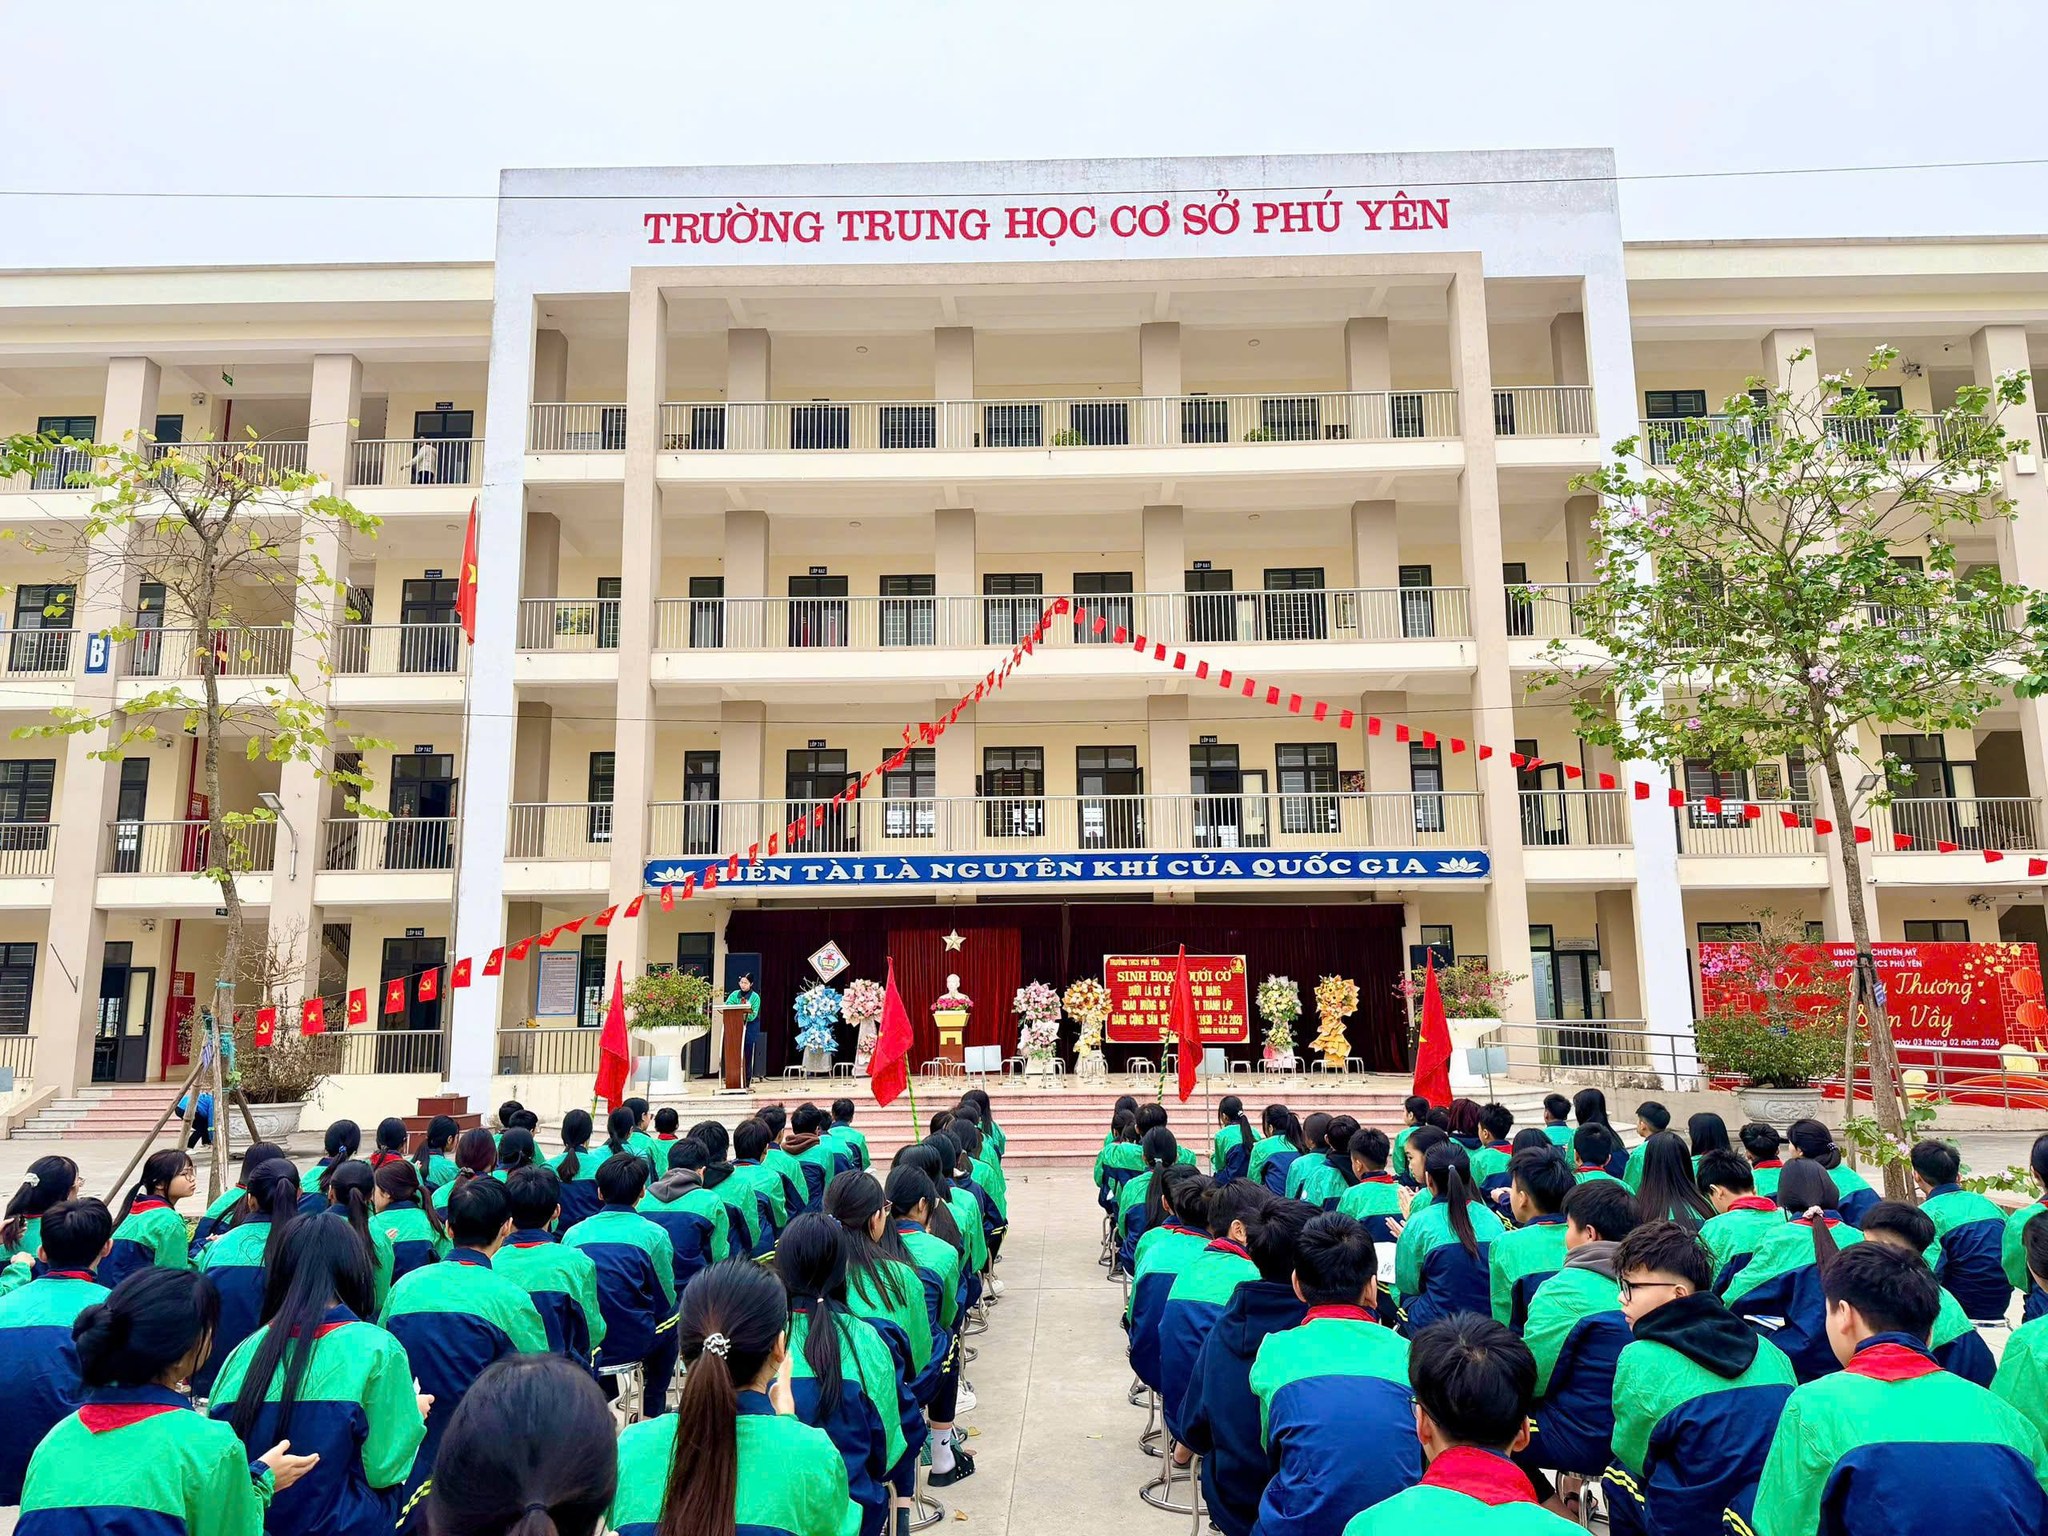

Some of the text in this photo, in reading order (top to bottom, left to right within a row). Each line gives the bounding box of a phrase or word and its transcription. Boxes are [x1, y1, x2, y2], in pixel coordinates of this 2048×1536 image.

[643, 189, 1451, 247] TRƯỜNG TRUNG HỌC CƠ SỞ PHÚ YÊN
[89, 638, 105, 668] B
[800, 859, 865, 881] TÀI
[873, 859, 920, 881] LÀ
[930, 857, 1085, 879] NGUYÊN
[1092, 854, 1160, 877] KHÍ
[1166, 854, 1244, 877] CỦA
[1251, 852, 1353, 877] QUỐC
[1357, 857, 1430, 875] GIA
[1871, 947, 1918, 956] CHUYÊN MỸ
[1889, 959, 1906, 968] PHÚ
[1907, 959, 1923, 967] YÊN
[1117, 970, 1147, 982] SINH
[1215, 966, 1232, 982] CỜ
[1895, 972, 1972, 1005] Thương
[1910, 1005, 1953, 1037] Vầy
[1893, 1038, 1911, 1046] gày
[1925, 1038, 1948, 1047] tháng
[1961, 1039, 1979, 1047] năm
[1981, 1039, 2000, 1047] 2026
